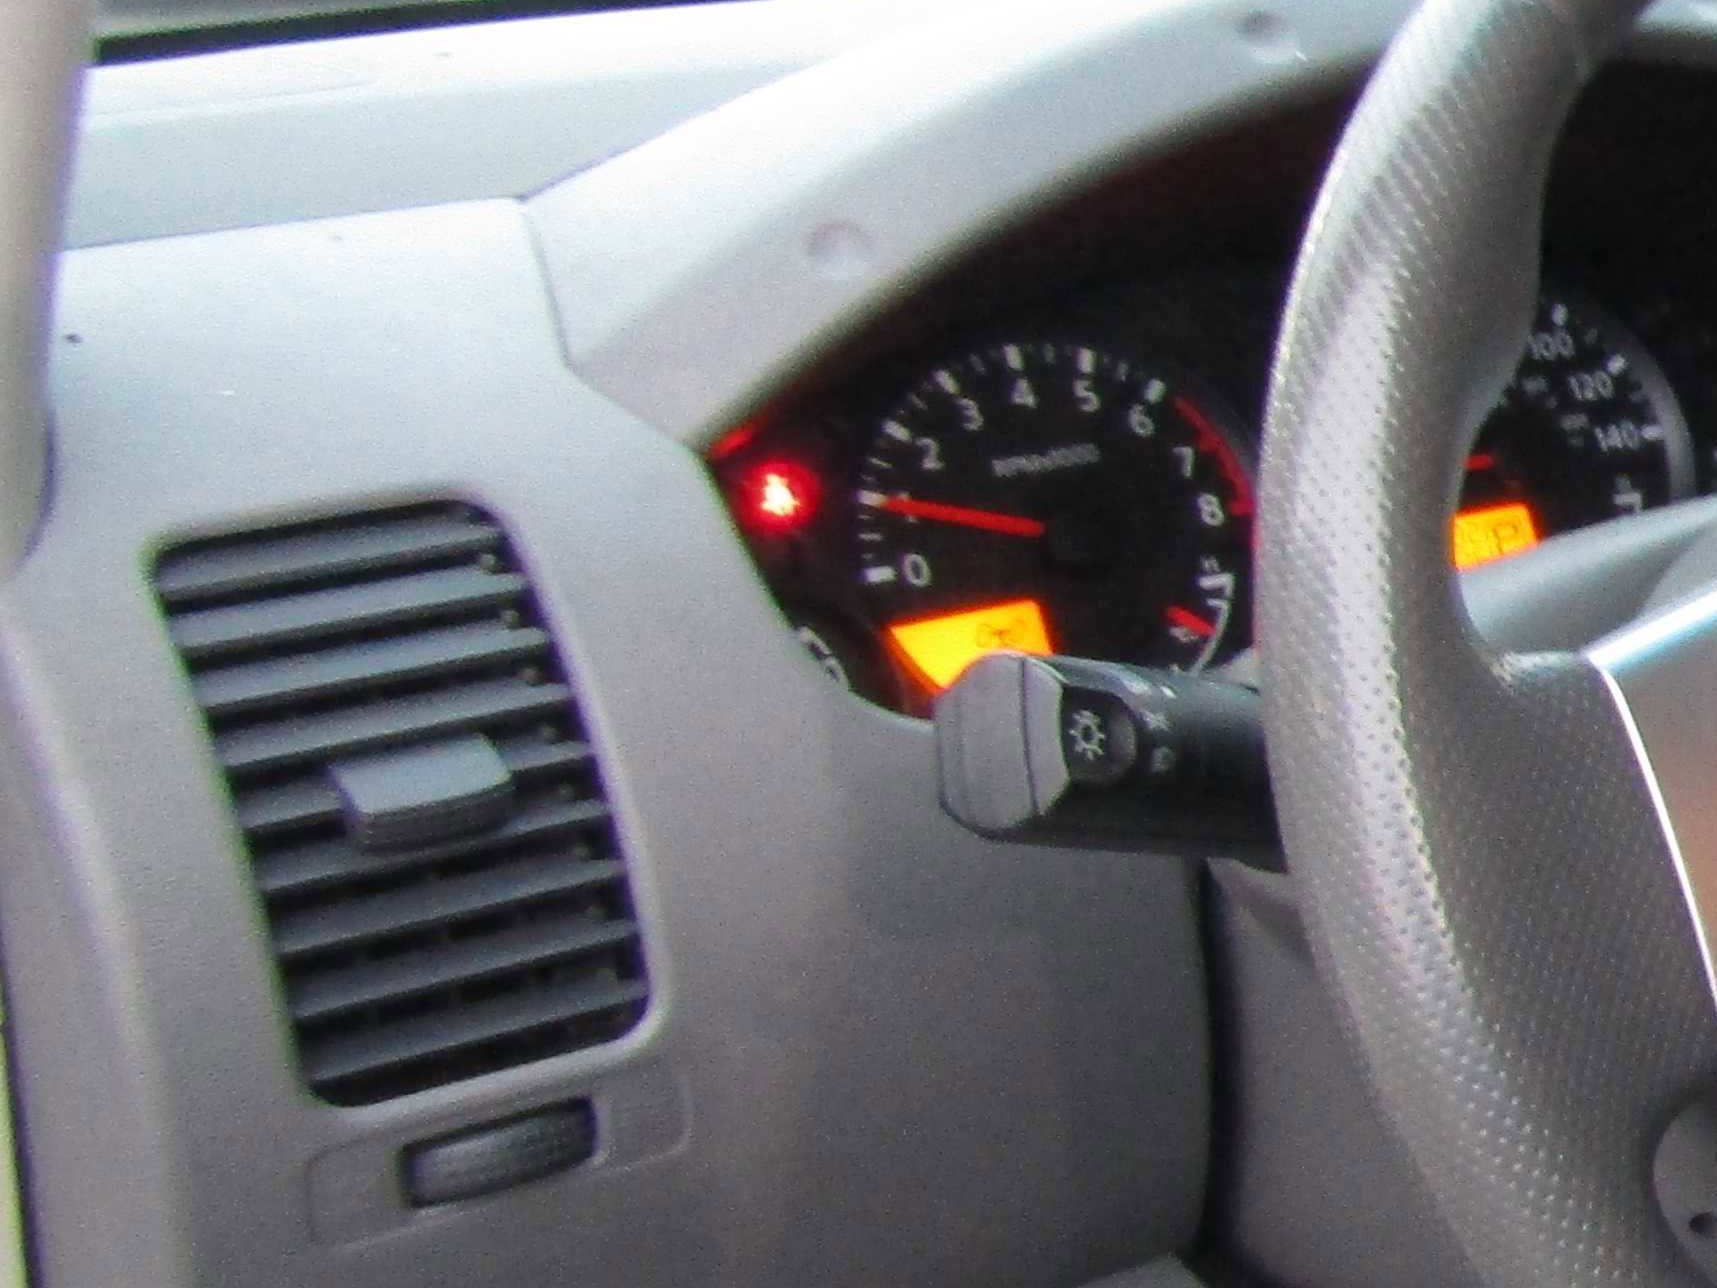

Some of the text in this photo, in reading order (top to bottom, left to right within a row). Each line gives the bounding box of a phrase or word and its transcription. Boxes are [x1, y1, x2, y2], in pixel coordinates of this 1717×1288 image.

[1011, 377, 1037, 409] 4
[1072, 379, 1100, 413] 5
[957, 397, 984, 432] 3
[1128, 406, 1155, 437] 6
[914, 437, 943, 471] 2
[1172, 446, 1196, 479] 7
[1198, 494, 1226, 528] 8
[902, 553, 932, 589] 0
